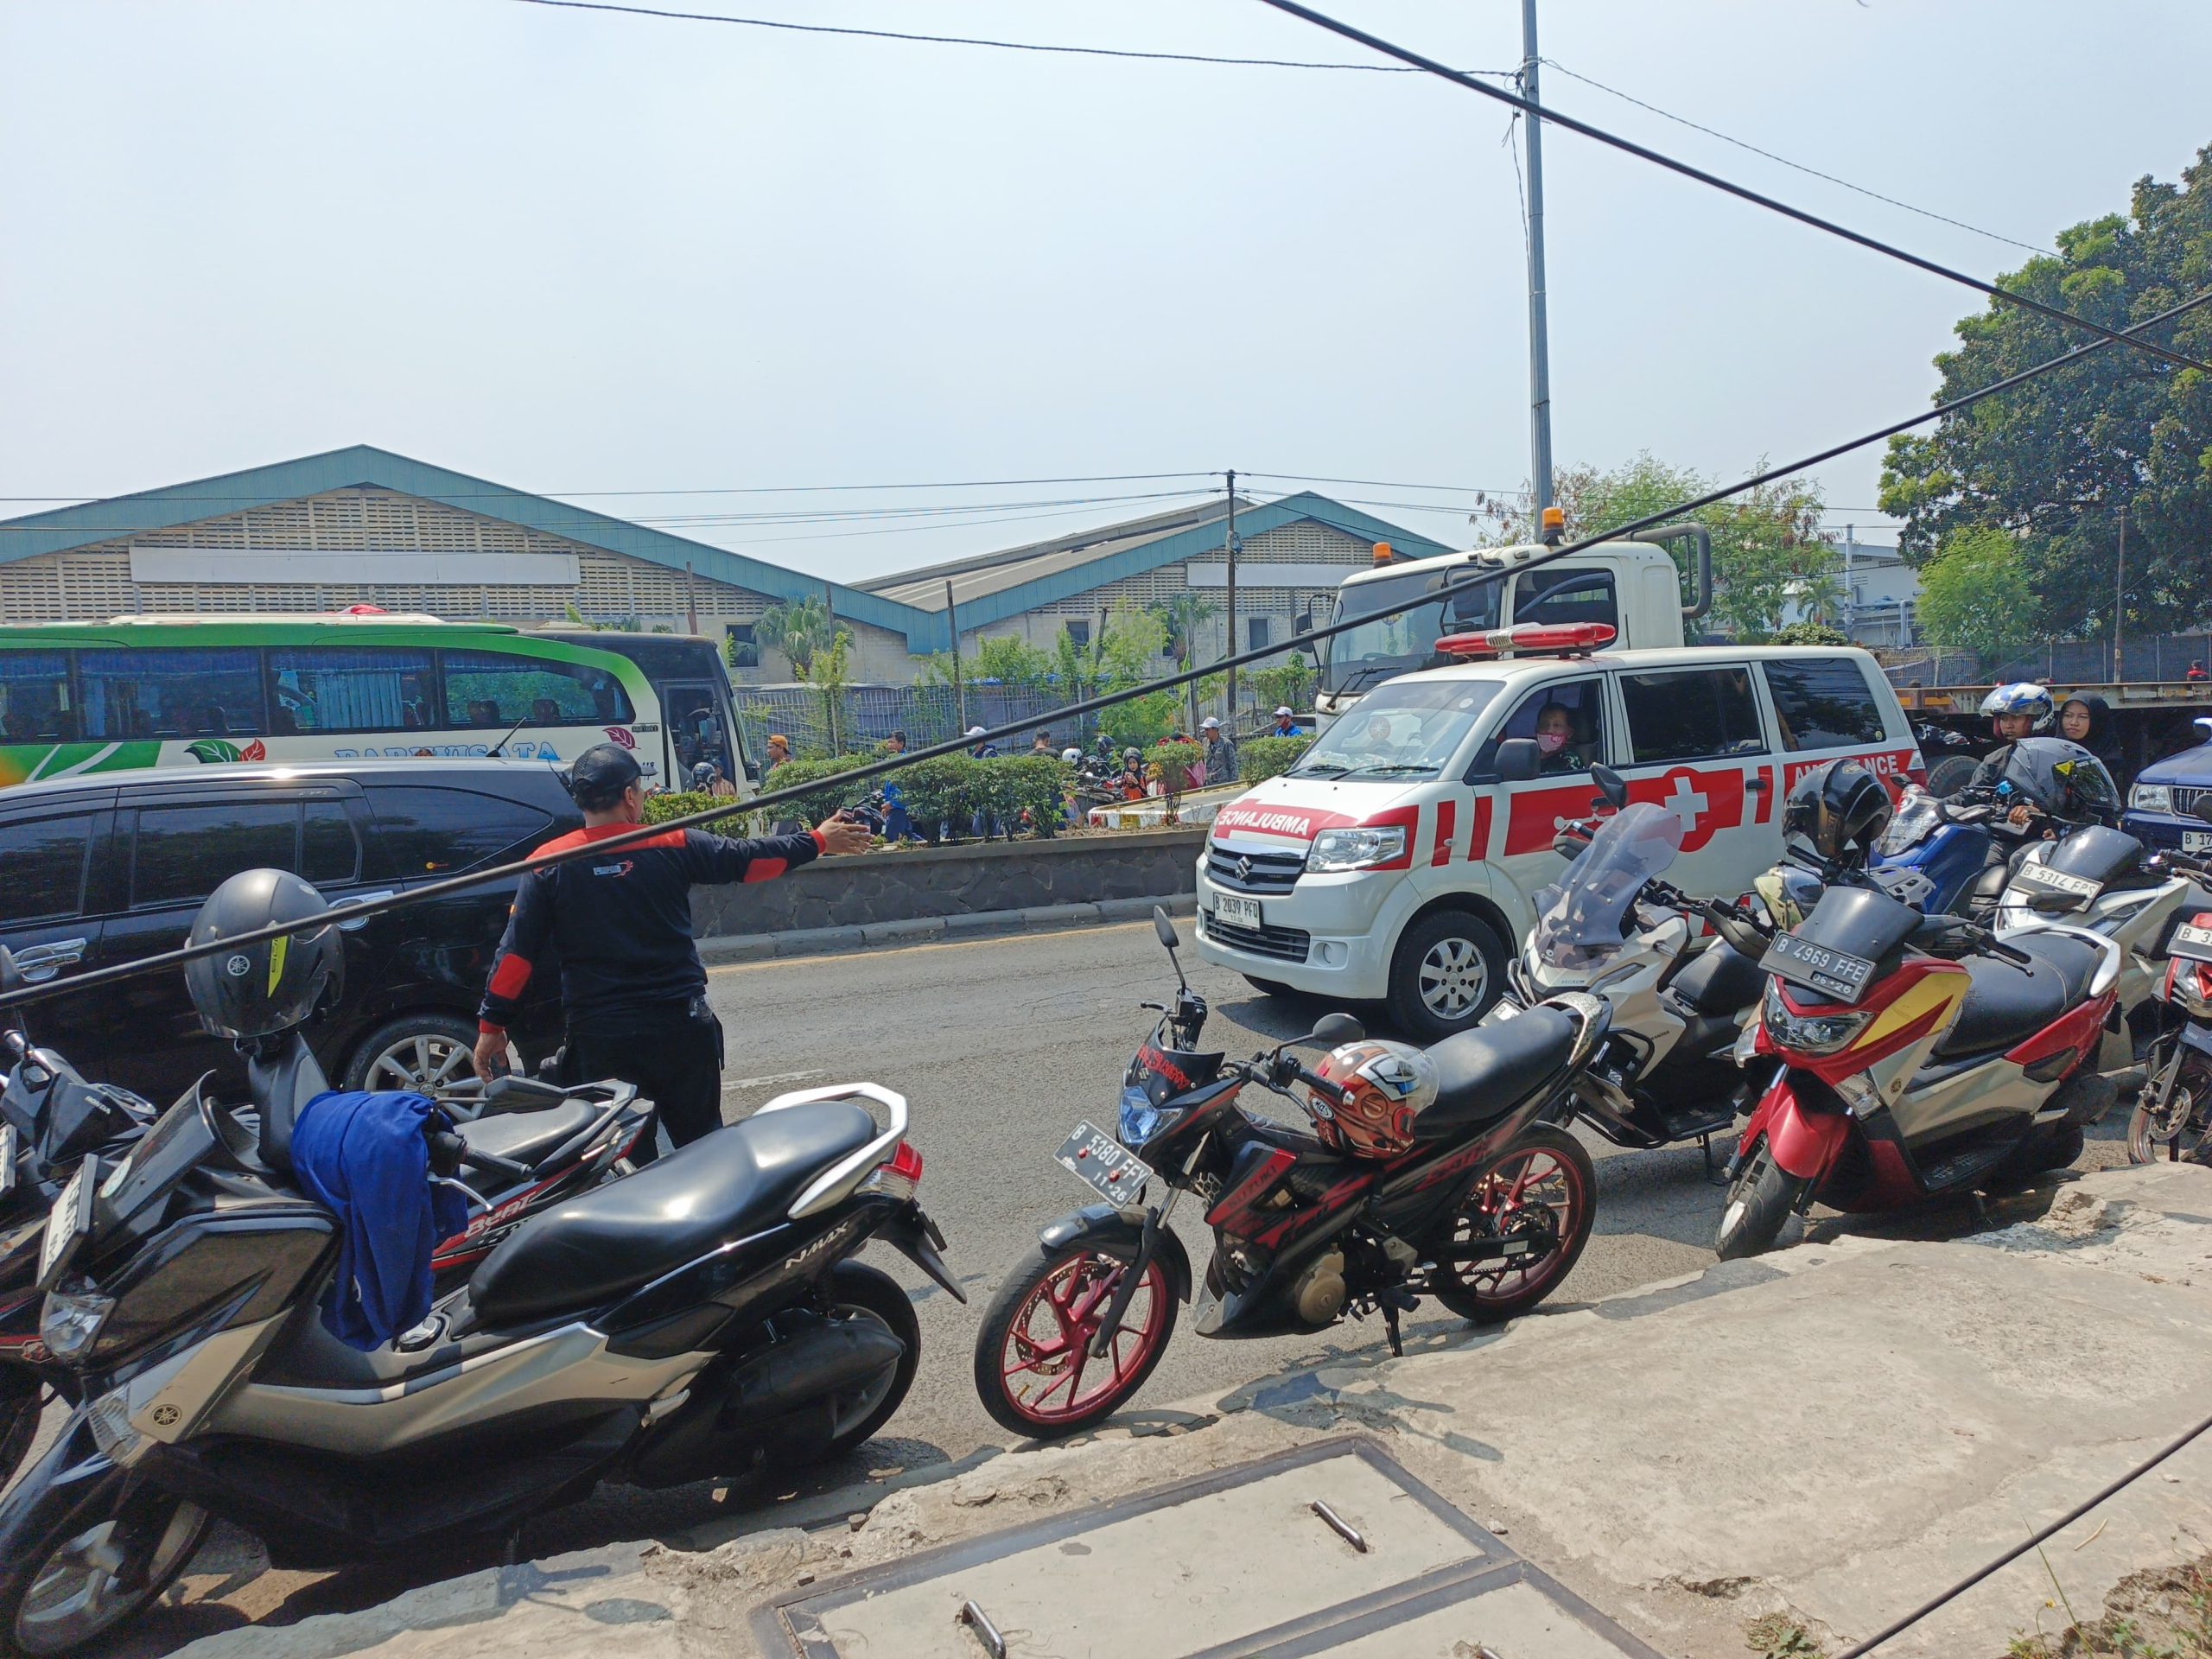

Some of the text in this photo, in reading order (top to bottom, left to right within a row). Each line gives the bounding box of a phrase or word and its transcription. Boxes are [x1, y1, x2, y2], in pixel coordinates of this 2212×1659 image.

[2185, 833, 2192, 845] B
[2024, 865, 2034, 876] B
[2069, 880, 2096, 896] FPS
[1215, 895, 1220, 910] B
[1223, 897, 1241, 914] 2039
[2182, 927, 2212, 944] B 3
[1777, 938, 1866, 981] B 4969 FFE
[85, 1095, 111, 1115] HONDA
[1071, 1125, 1087, 1141] B
[1085, 1134, 1121, 1166] 5380
[1117, 1159, 1148, 1187] FFY
[1227, 1165, 1277, 1209] SUZUKI
